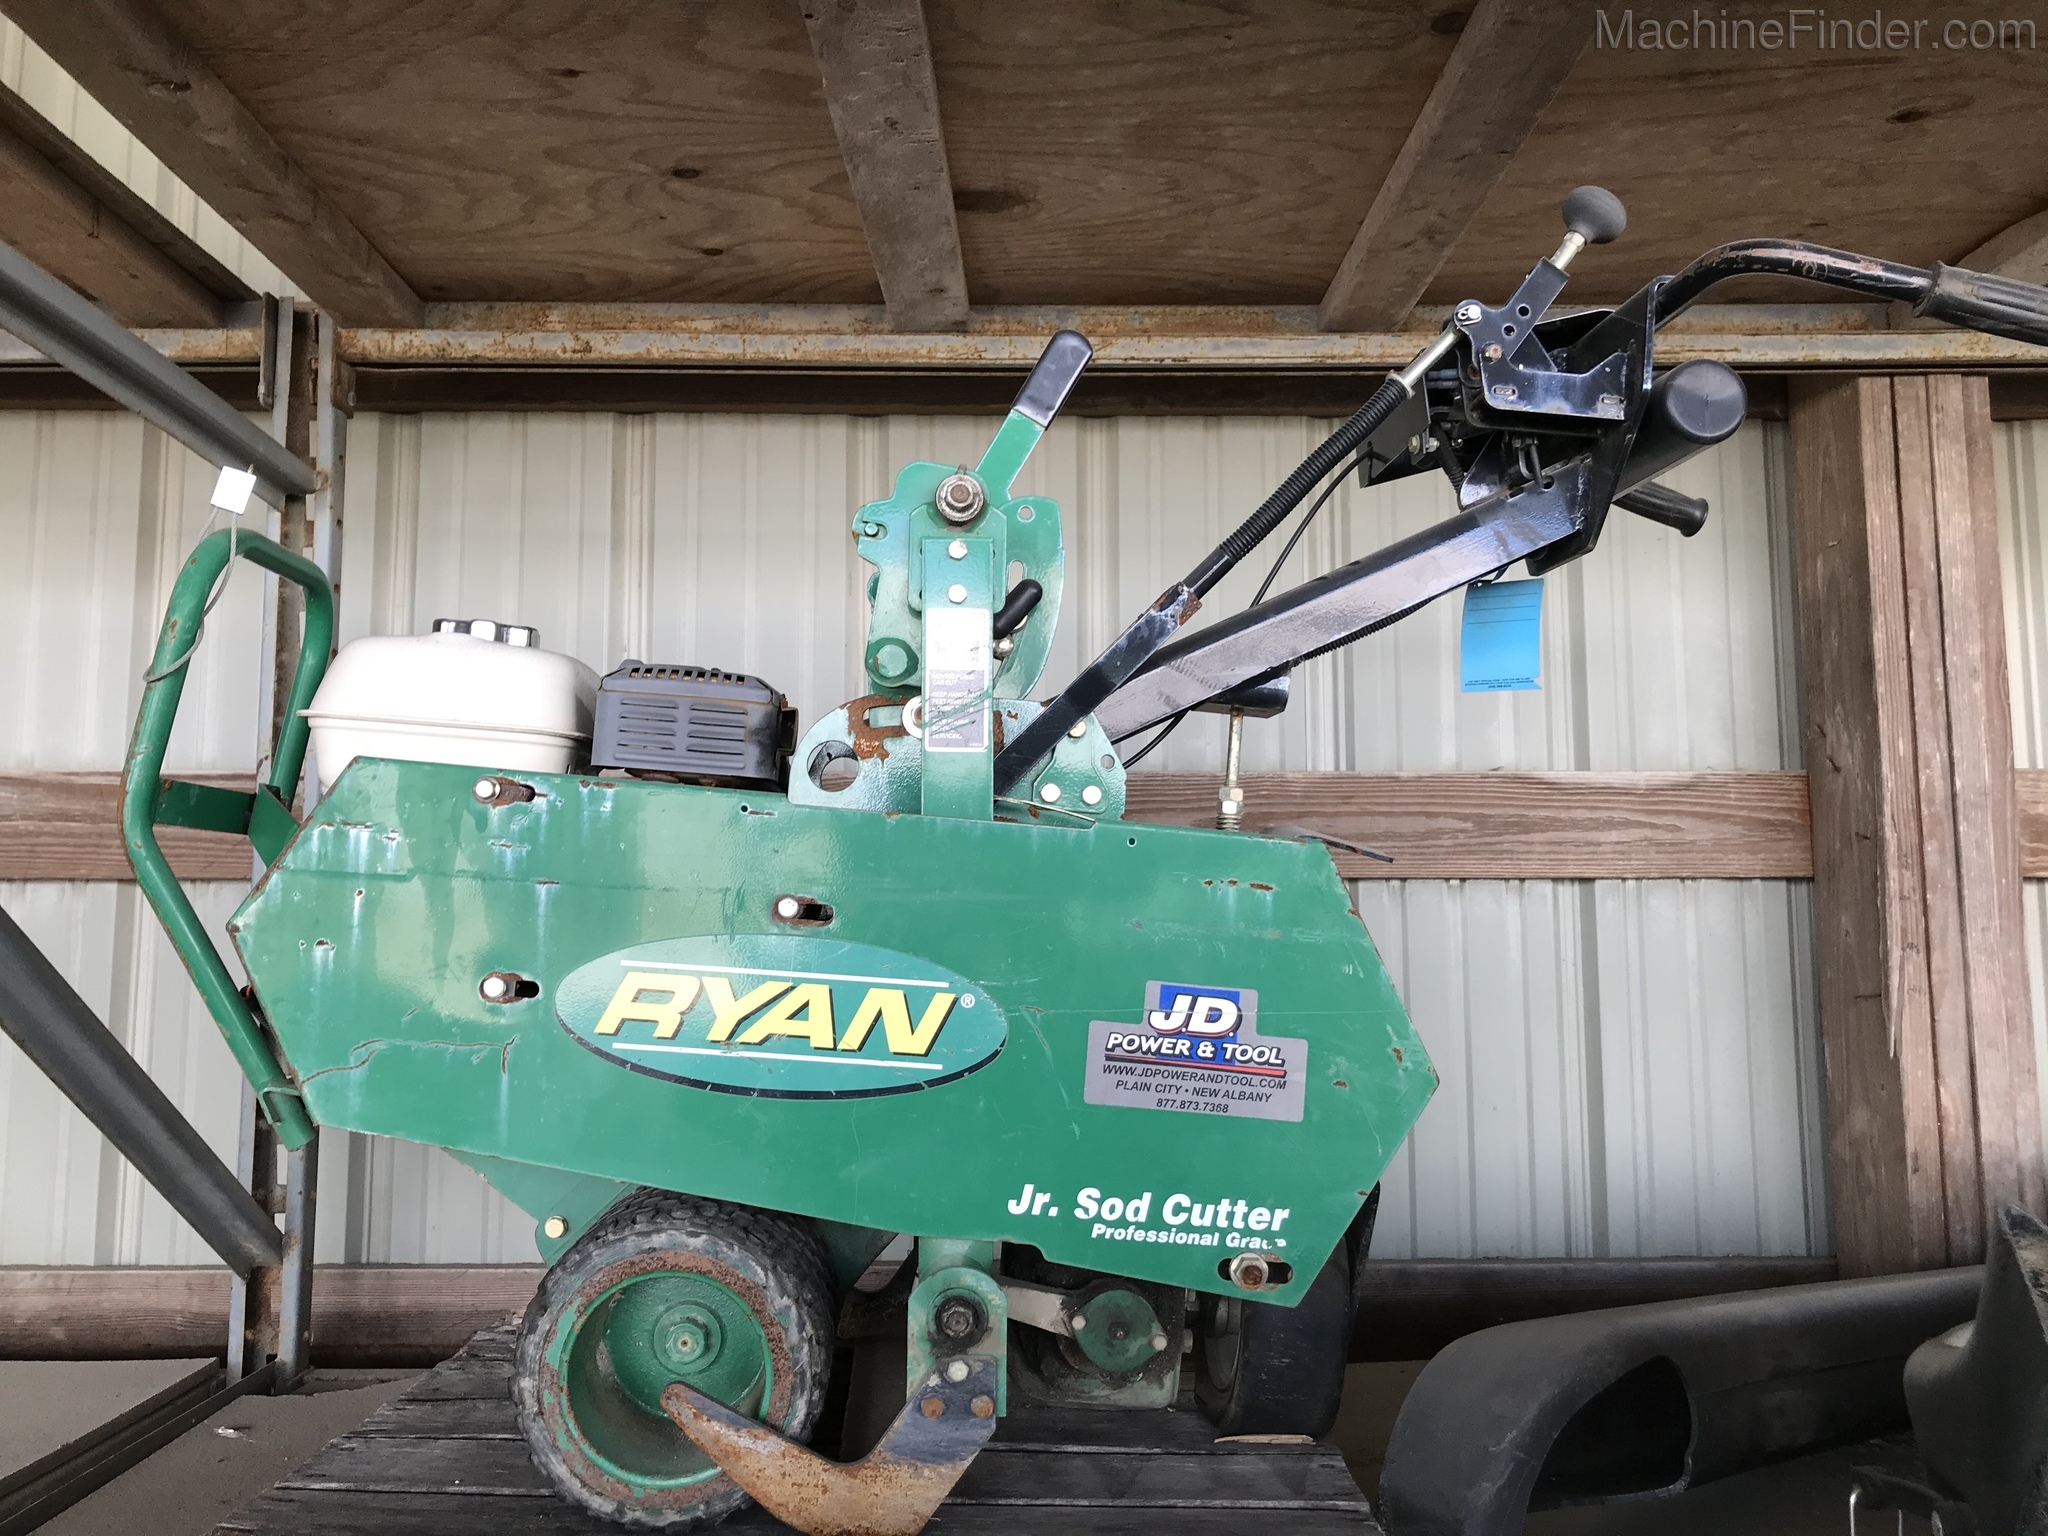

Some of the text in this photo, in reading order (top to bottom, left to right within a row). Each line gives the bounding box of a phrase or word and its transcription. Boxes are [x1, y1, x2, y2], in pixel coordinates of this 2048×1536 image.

[593, 971, 959, 1057] RYAN
[1105, 1032, 1286, 1067] POWER & TOOL
[1102, 1063, 1288, 1090] WWW.JDPOWERANDTOOL.COM
[1115, 1079, 1272, 1103] PLAIN CITY NEW ALBANY
[1156, 1098, 1229, 1113] 877.873.7368
[1007, 1183, 1290, 1232] Jr. Sod Cutter
[1090, 1223, 1220, 1247] Professional
